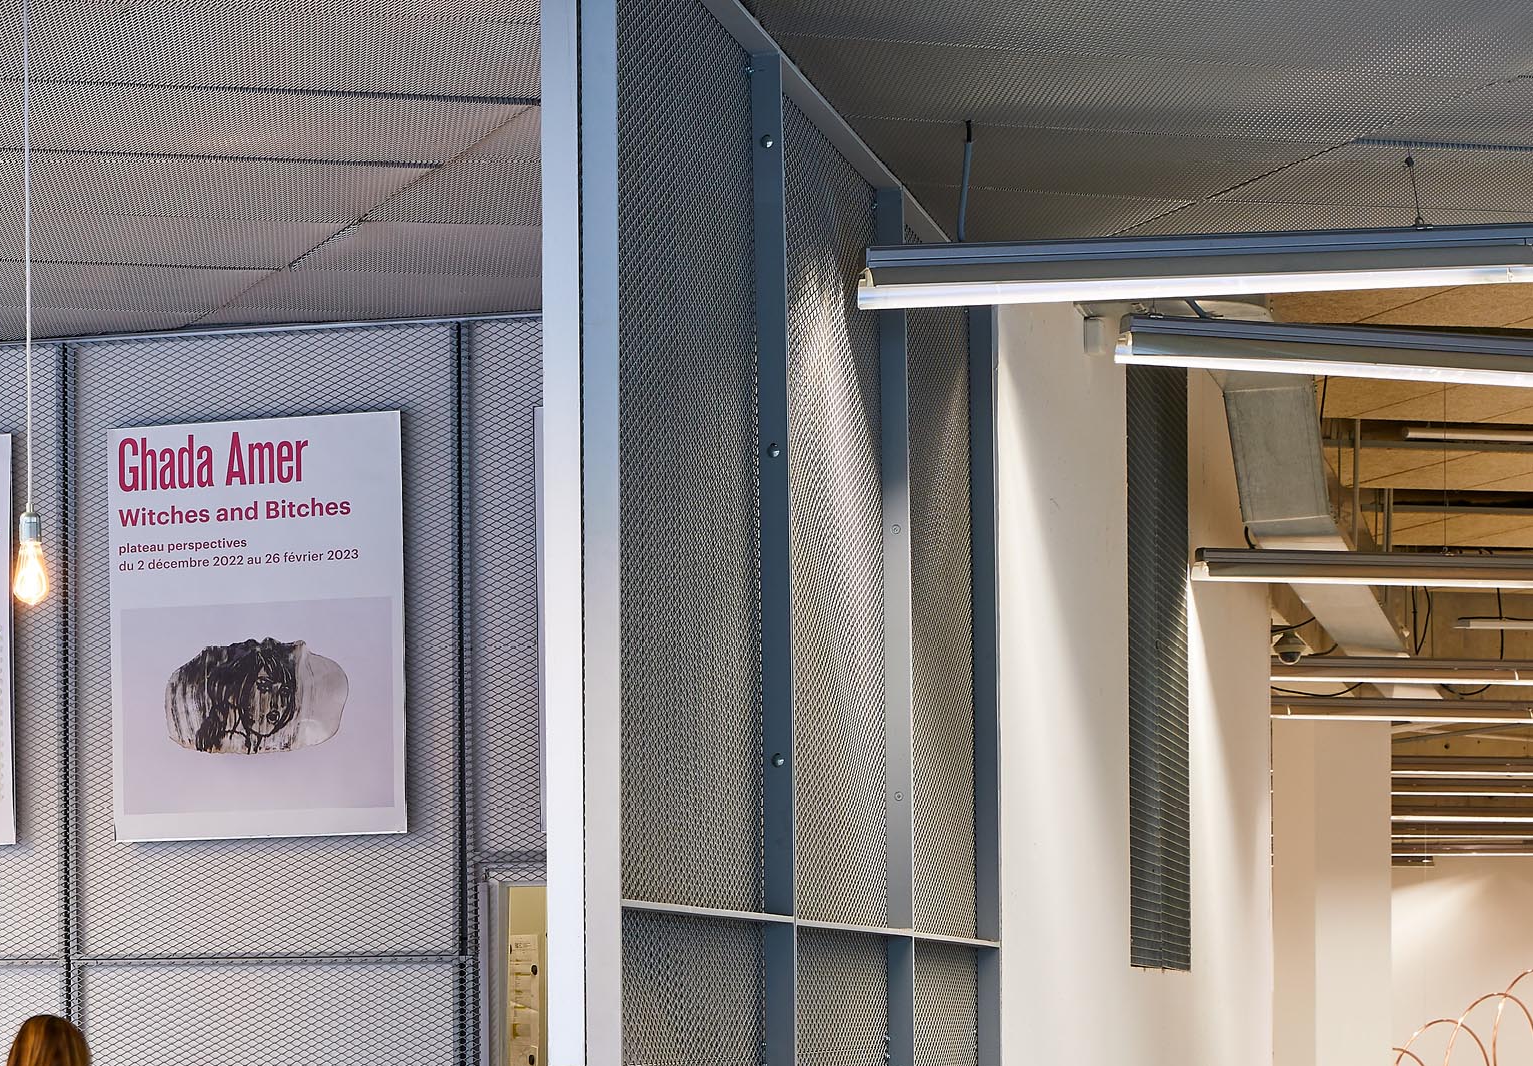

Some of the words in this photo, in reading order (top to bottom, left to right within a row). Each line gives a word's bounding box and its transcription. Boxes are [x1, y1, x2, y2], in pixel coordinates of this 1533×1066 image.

[118, 434, 214, 492] Ghada
[226, 432, 308, 486] Amer
[118, 506, 209, 527] Witches
[216, 501, 258, 522] and
[266, 498, 350, 519] Bitches
[119, 542, 164, 554] plateau
[168, 538, 247, 553] perspectives
[119, 561, 133, 571] du
[138, 560, 144, 570] 2
[148, 557, 209, 570] décembre
[213, 555, 244, 567] 2022
[247, 556, 262, 565] au
[266, 553, 280, 564] 26
[284, 550, 323, 563] février
[327, 549, 359, 560] 2023
